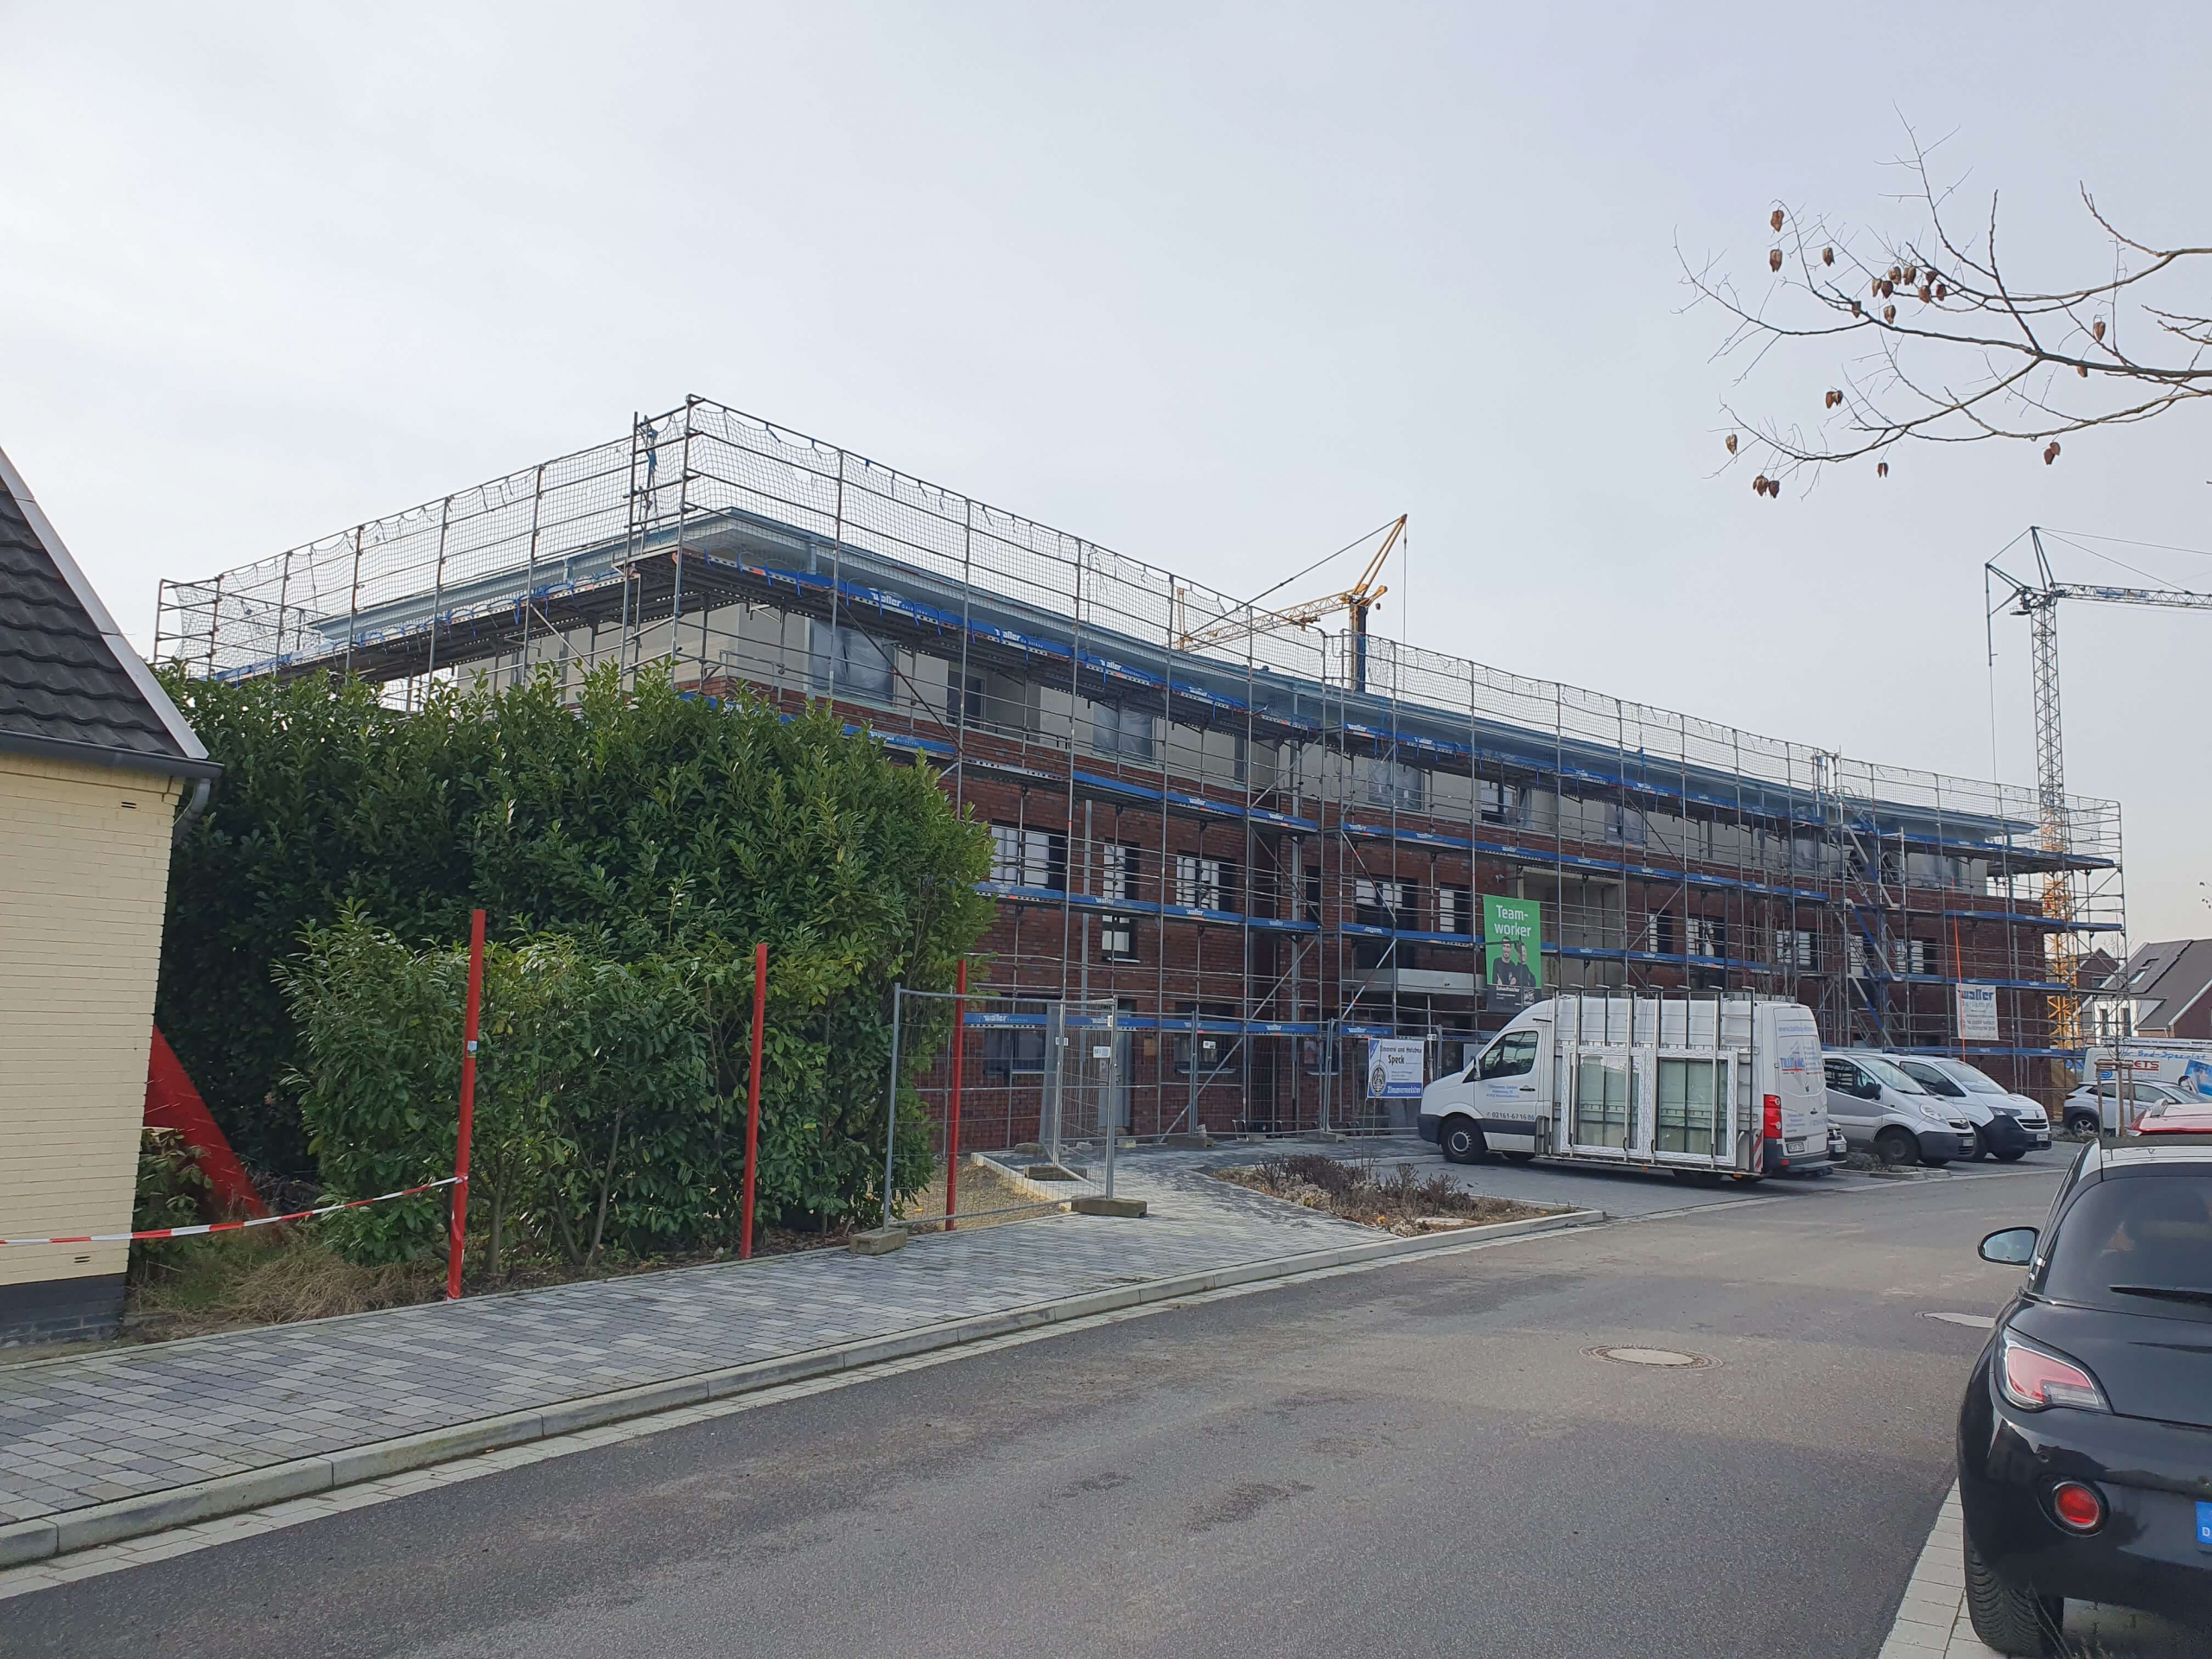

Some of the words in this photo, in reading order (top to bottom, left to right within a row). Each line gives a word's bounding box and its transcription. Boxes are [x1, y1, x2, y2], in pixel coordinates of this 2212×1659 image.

[1496, 905, 1529, 921] Team-
[1494, 922, 1532, 937] worker
[1388, 1054, 1405, 1065] Speck
[2202, 1526, 2211, 1537] D
